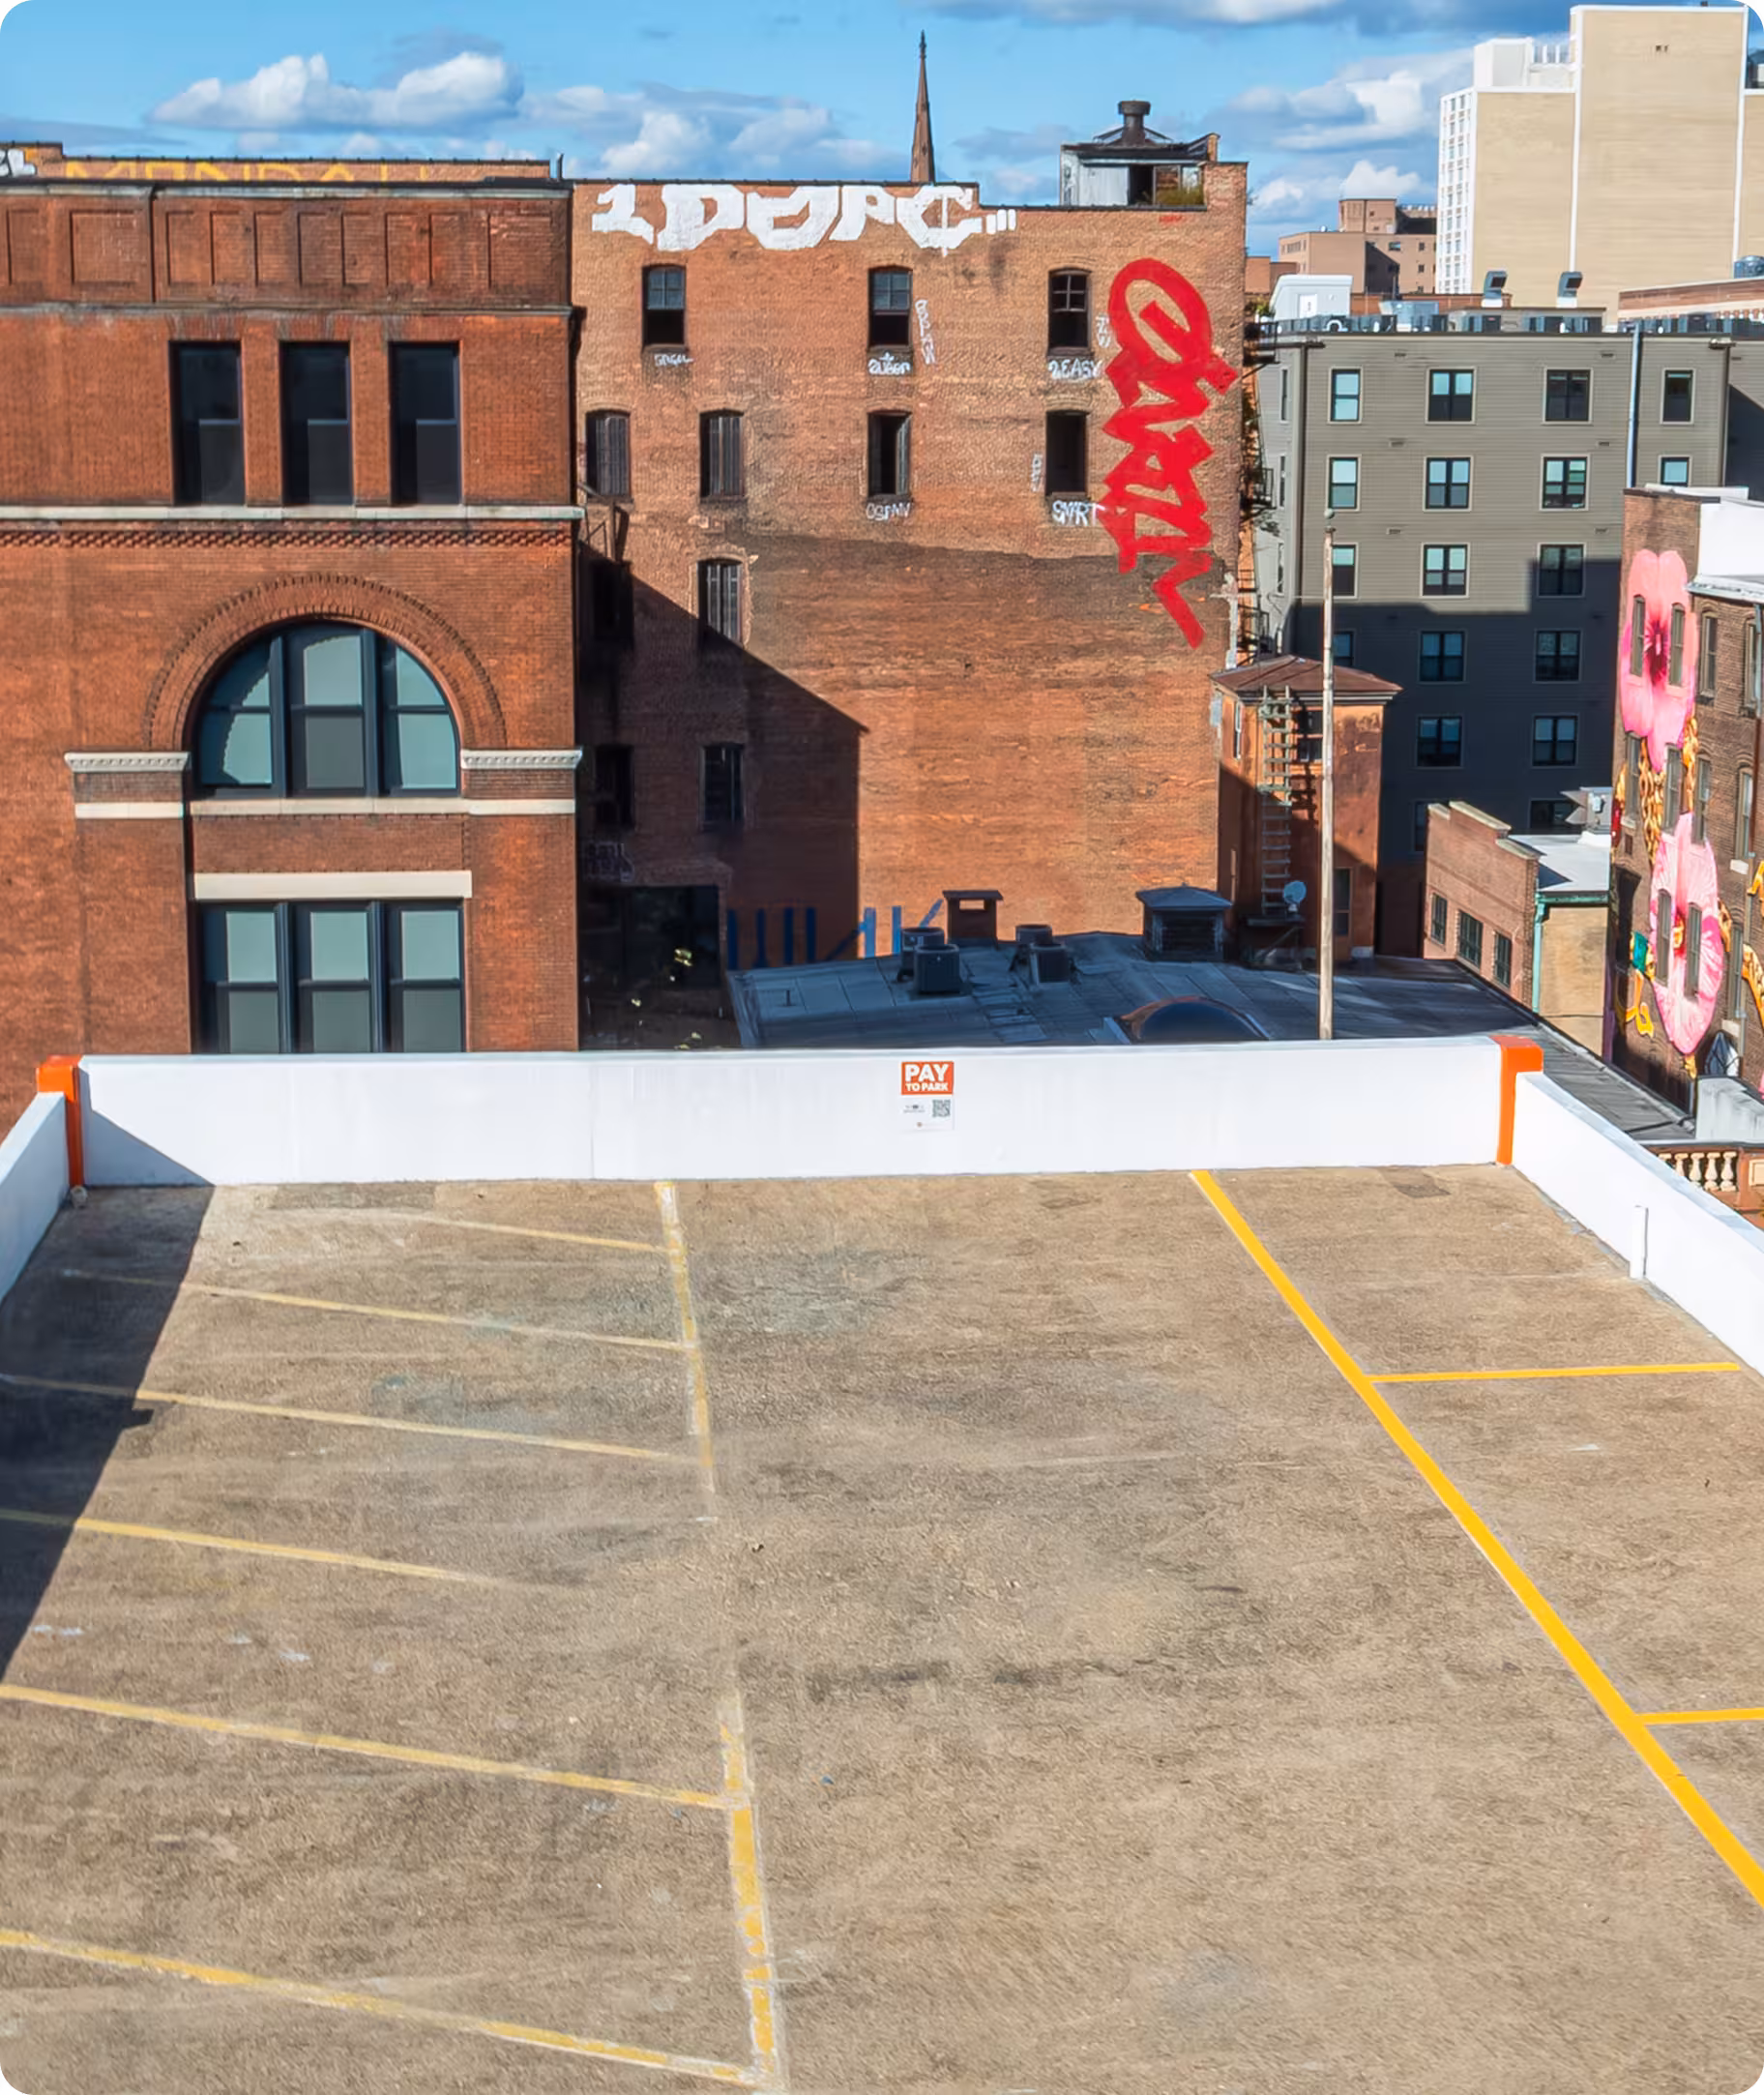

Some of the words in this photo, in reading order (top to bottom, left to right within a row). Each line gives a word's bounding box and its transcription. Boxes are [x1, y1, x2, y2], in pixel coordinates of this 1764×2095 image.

[904, 1063, 949, 1082] PAY
[905, 1082, 920, 1091] TO
[922, 1082, 949, 1091] PARK
